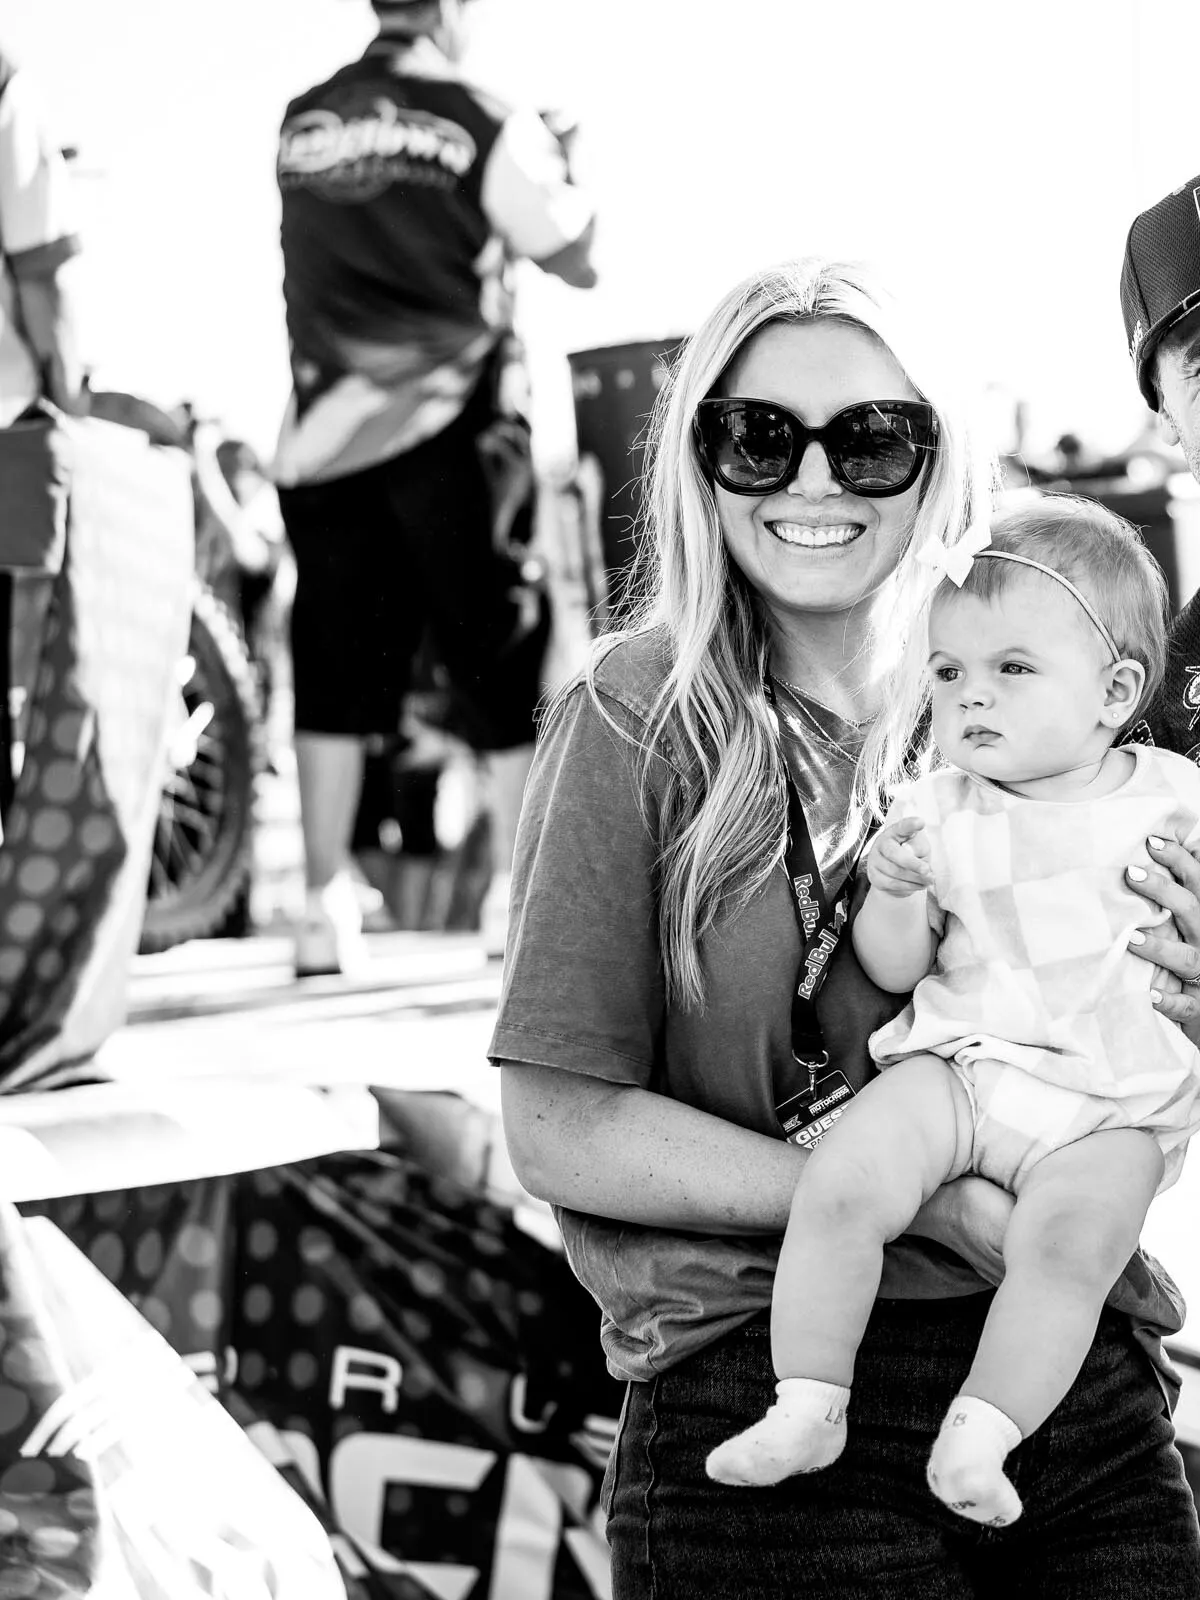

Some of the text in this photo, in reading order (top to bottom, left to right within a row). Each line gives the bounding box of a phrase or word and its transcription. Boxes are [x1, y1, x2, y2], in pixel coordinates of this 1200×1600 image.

[794, 873, 820, 910] Red
[798, 928, 839, 1001] Red Bull
[809, 1085, 850, 1115] MOTOCROSS
[795, 1102, 850, 1146] GUES
